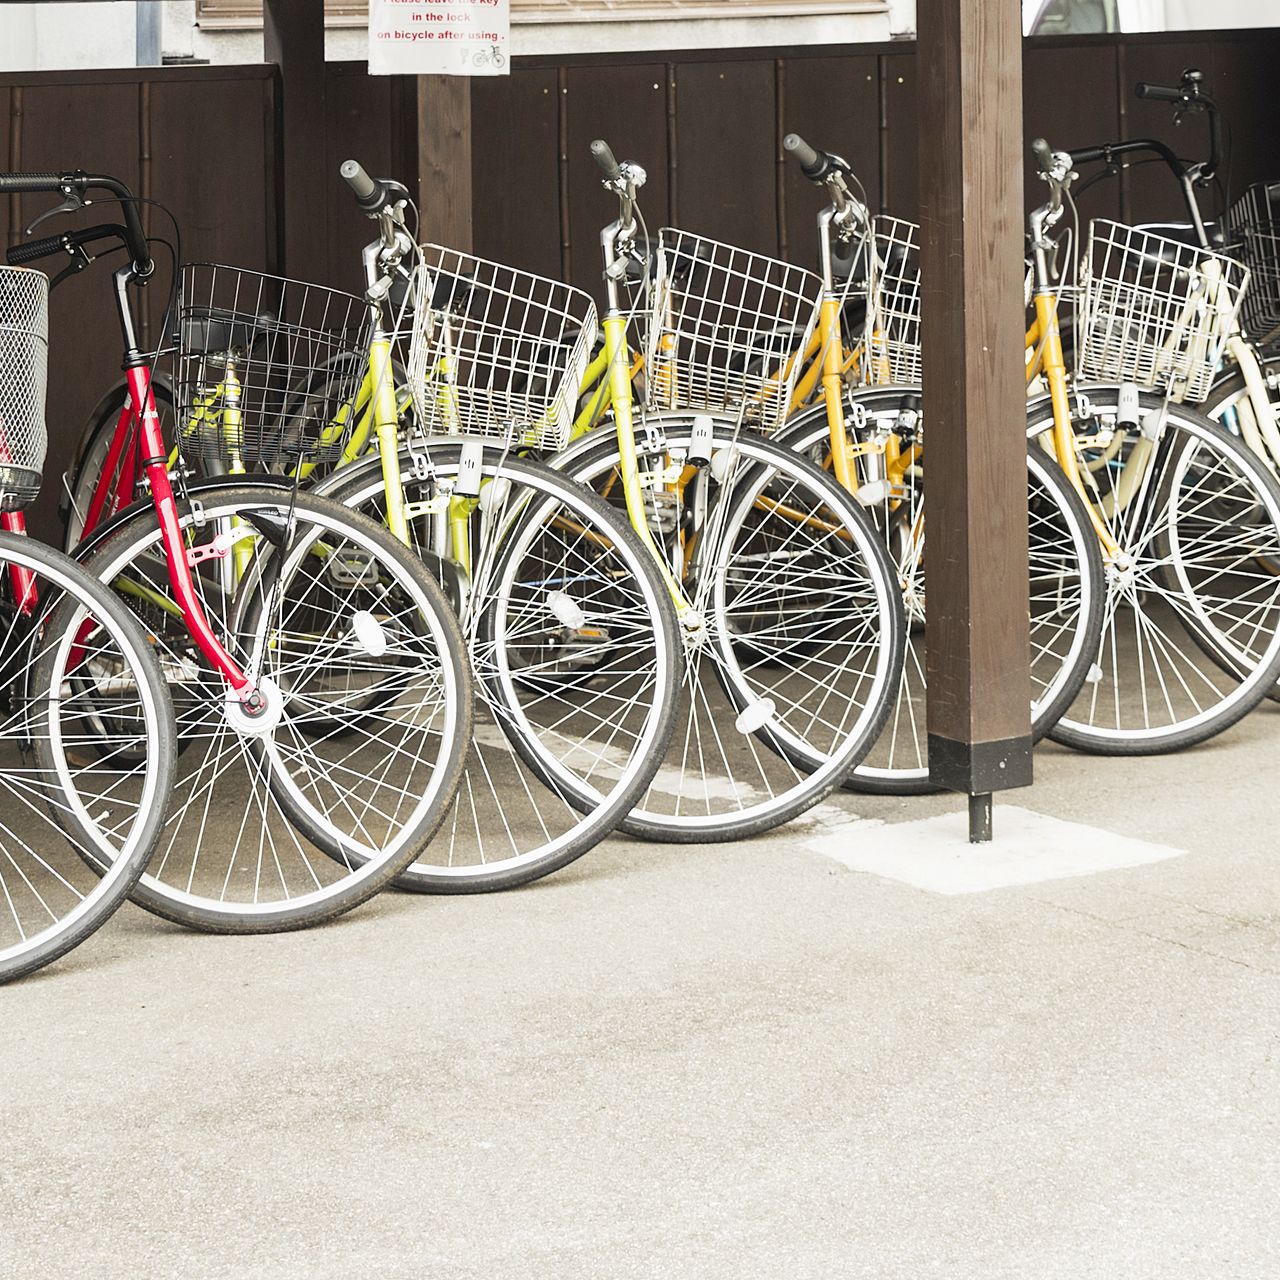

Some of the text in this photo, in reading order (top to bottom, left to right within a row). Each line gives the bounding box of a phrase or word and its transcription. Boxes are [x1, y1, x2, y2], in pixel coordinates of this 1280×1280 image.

[412, 12, 471, 22] in the lock
[377, 32, 391, 40] on
[393, 30, 435, 41] bicycle
[437, 30, 464, 40] after
